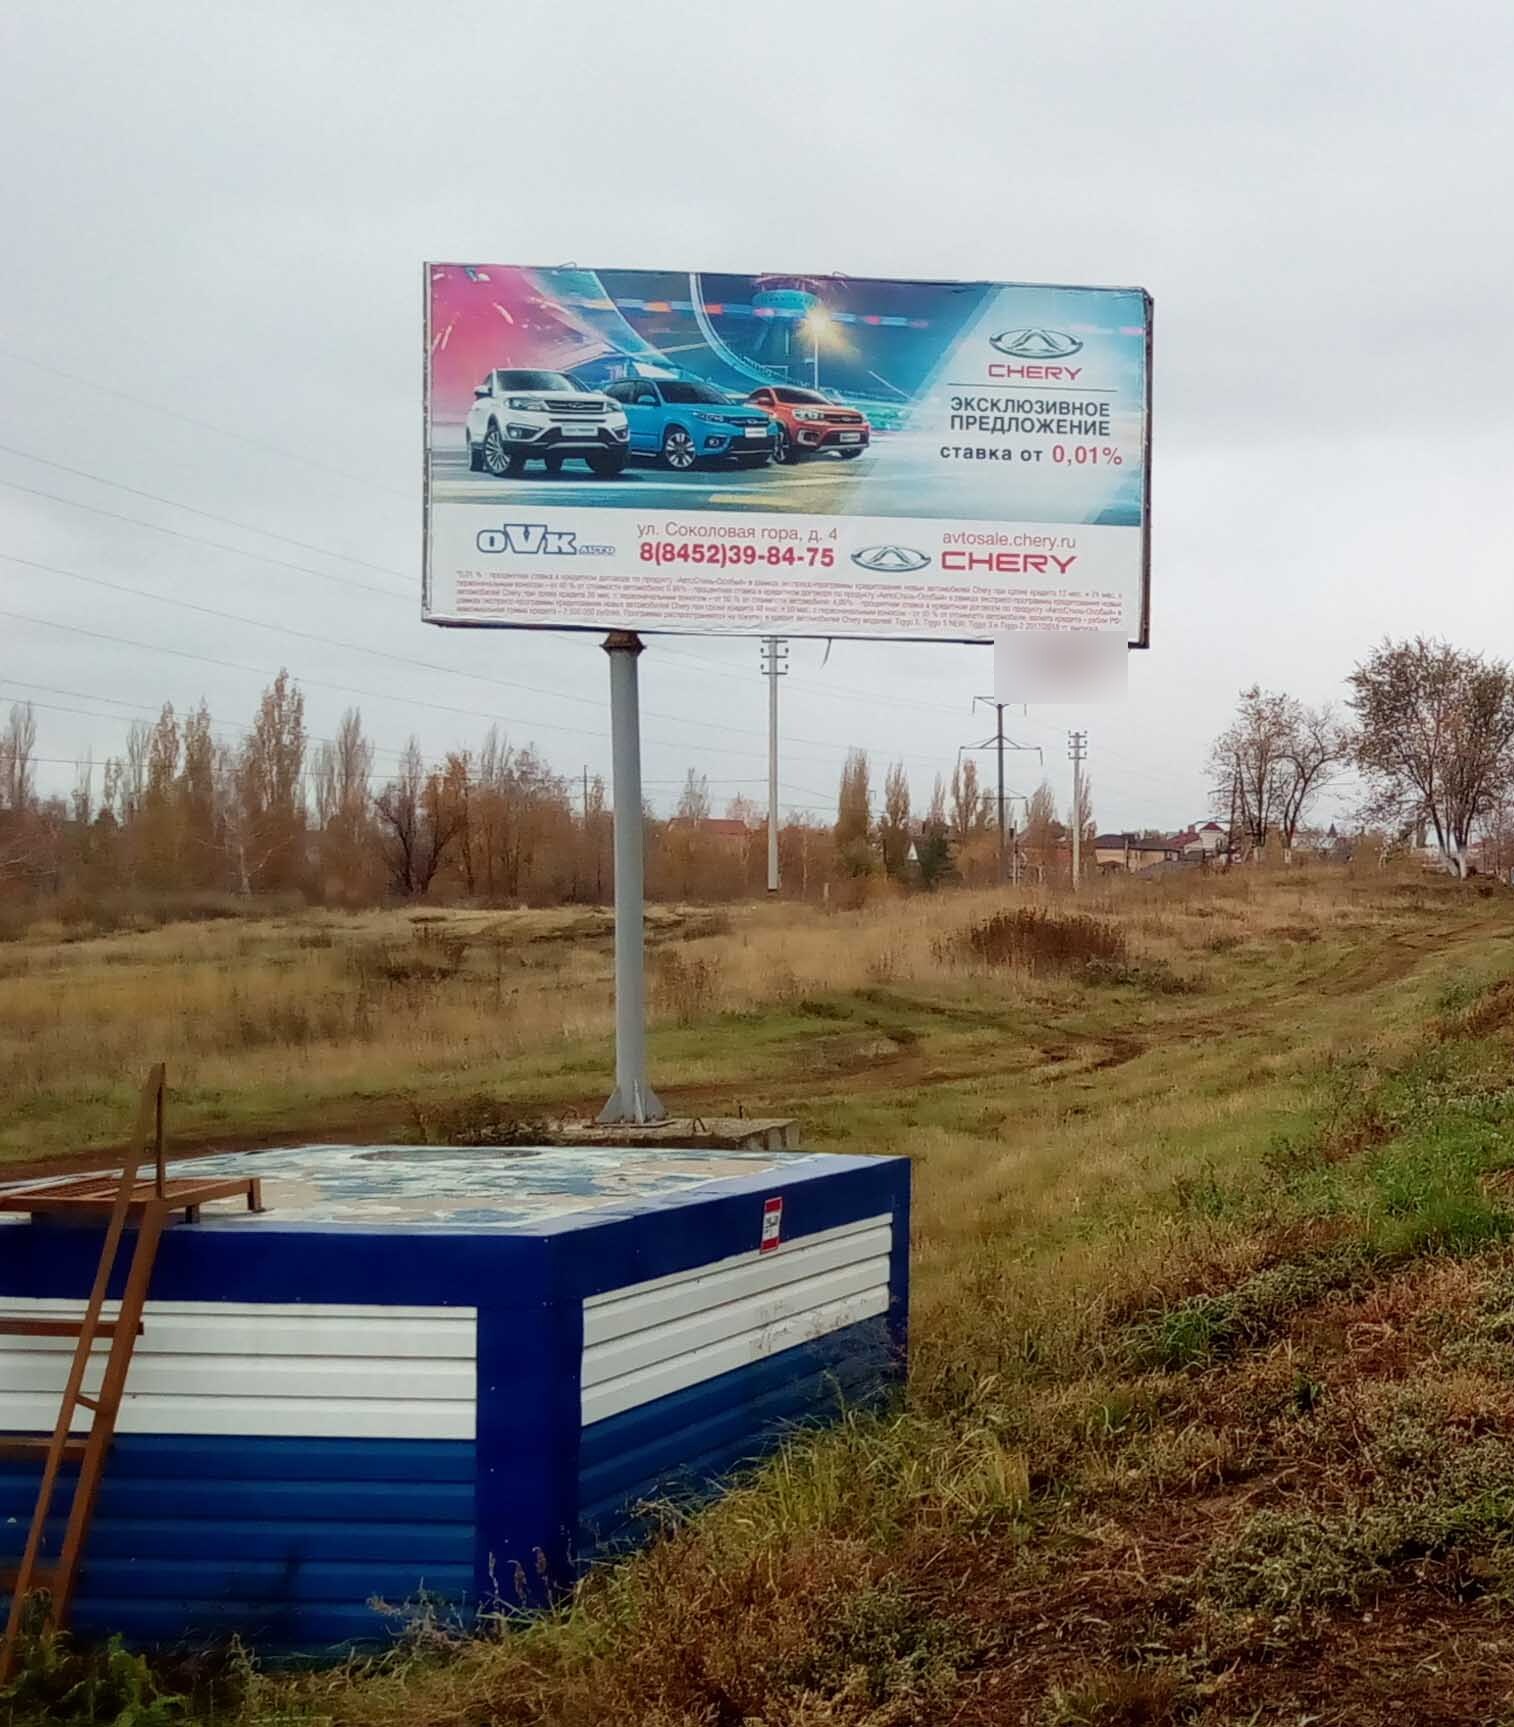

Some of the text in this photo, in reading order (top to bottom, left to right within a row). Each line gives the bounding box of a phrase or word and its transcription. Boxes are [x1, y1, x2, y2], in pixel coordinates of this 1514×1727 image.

[988, 363, 1083, 381] CHERY
[950, 396, 1111, 418] ЭКСКЛЮЗИВНОЕ
[950, 415, 1111, 436] ПРЕДЛОЖЕНИЕ
[940, 444, 1123, 465] ставка от 0,01%
[637, 522, 839, 543] ул. Соколовая гора, д. 4
[942, 531, 1077, 550] avtosale.chery.ru
[639, 541, 835, 568] 8(8452)39-84-75
[941, 551, 1077, 575] CHERY
